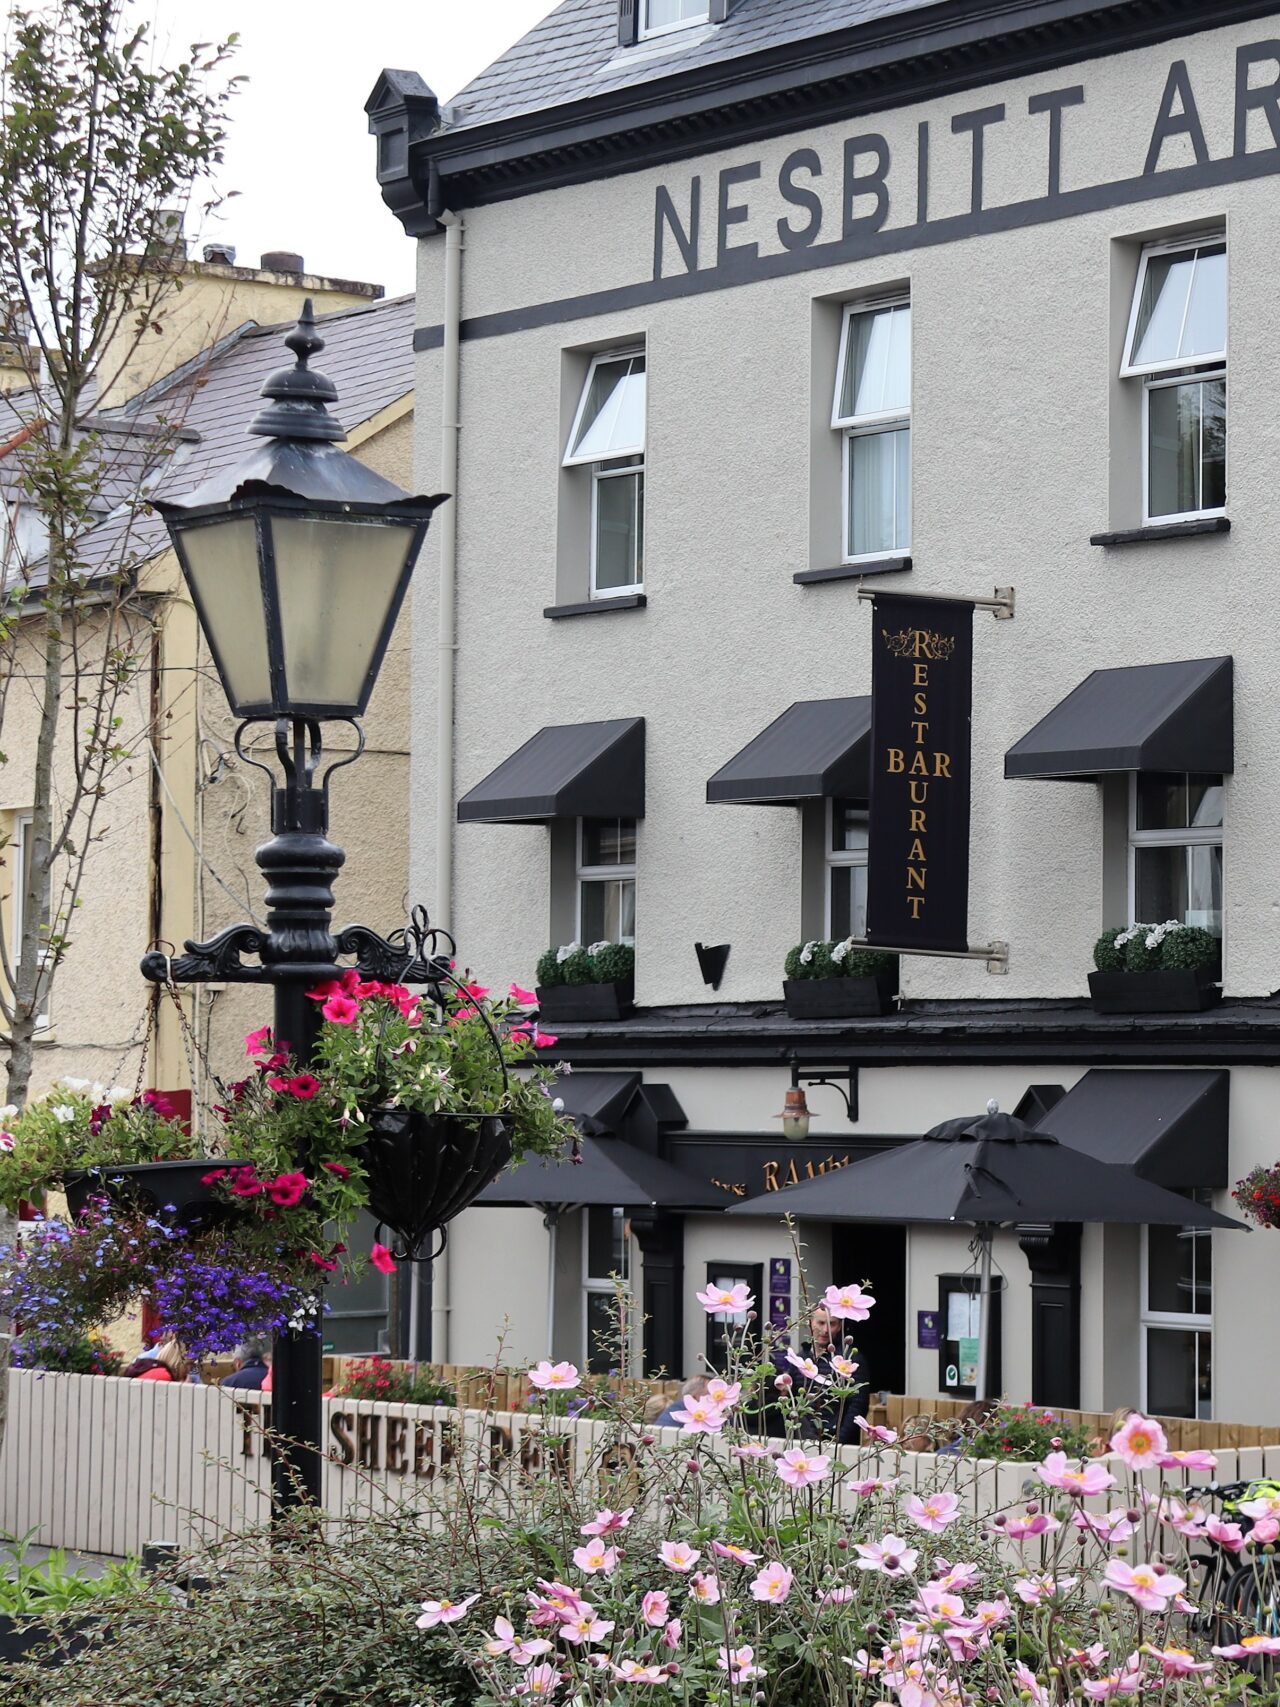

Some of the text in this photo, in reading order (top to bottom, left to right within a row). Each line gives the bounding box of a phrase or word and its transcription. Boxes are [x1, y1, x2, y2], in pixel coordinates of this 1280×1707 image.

[653, 85, 1085, 281] NESBITT
[887, 748, 951, 778] BAR
[906, 630, 934, 919] RESTAURANT
